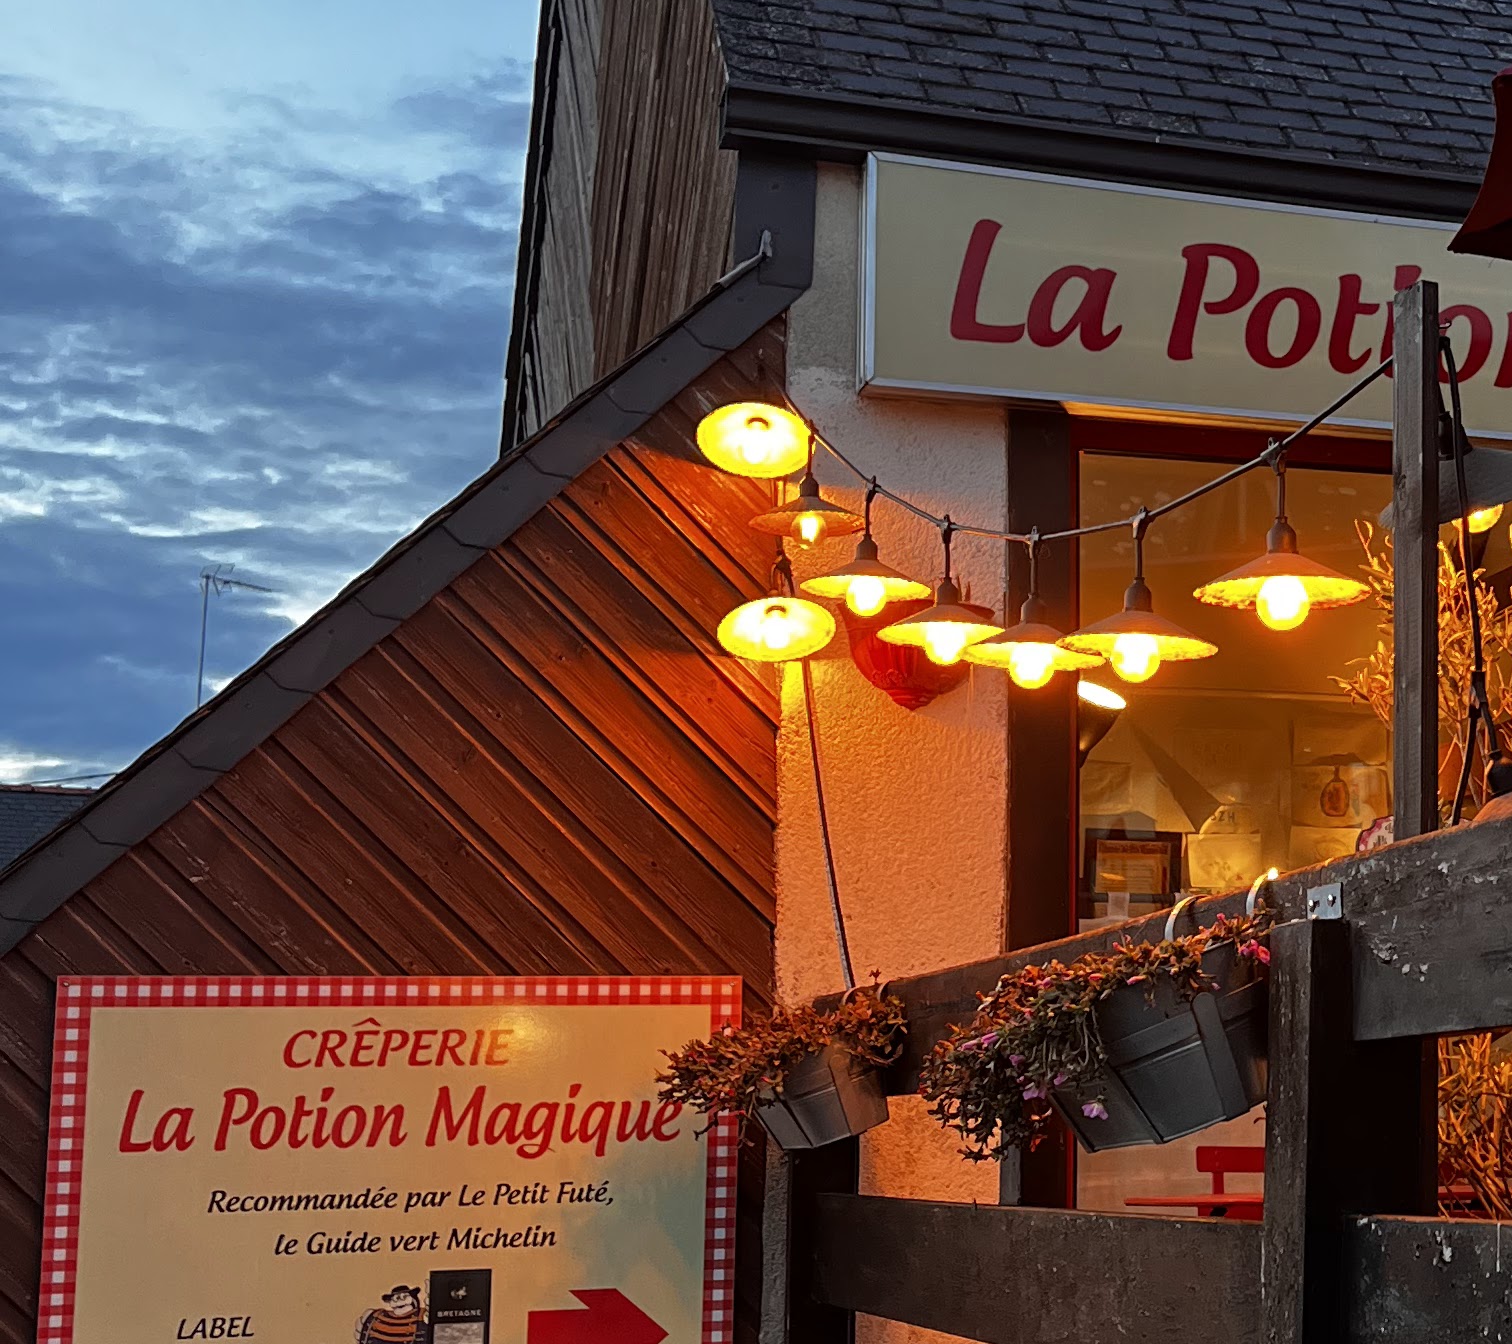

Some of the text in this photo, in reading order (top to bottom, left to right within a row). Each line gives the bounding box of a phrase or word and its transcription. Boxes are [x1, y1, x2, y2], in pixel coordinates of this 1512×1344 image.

[951, 220, 1122, 352] La
[283, 1017, 514, 1068] CRÊPERIE
[119, 1083, 682, 1159] La Potion Magique
[207, 1180, 614, 1213] Recommandée par Le Petit Futé,
[274, 1225, 557, 1256] le Guide vert Michelin
[176, 1316, 255, 1340] LABEL
[437, 1309, 482, 1318] BRETAGNE
